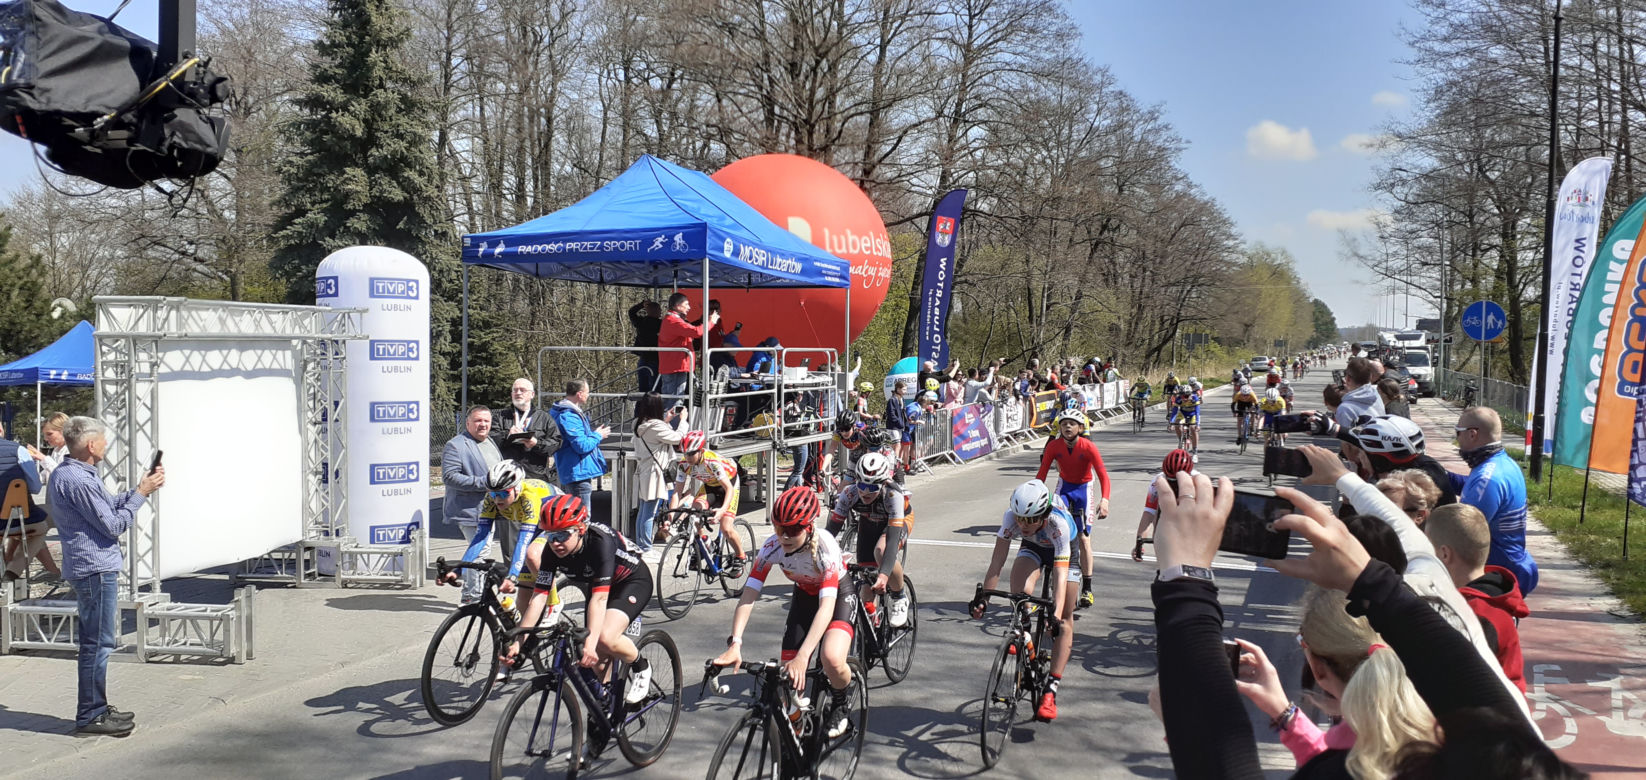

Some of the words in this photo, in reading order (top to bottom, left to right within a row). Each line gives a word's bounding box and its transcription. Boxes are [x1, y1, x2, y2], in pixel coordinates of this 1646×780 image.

[517, 241, 563, 255] RADOŚĆ
[565, 241, 601, 253] PRZEZ
[603, 239, 642, 252] SPORT
[768, 252, 803, 275] Lubartów
[374, 279, 418, 296] TVP3
[381, 303, 412, 312] LUBLIN
[374, 342, 418, 358] TVP3
[381, 365, 412, 374] LUBLIN
[374, 403, 418, 420] TVP3
[381, 427, 412, 435] LUBLIN
[1381, 435, 1402, 443] KASK
[374, 464, 418, 482] TVP3
[381, 488, 412, 497] LUBLIN
